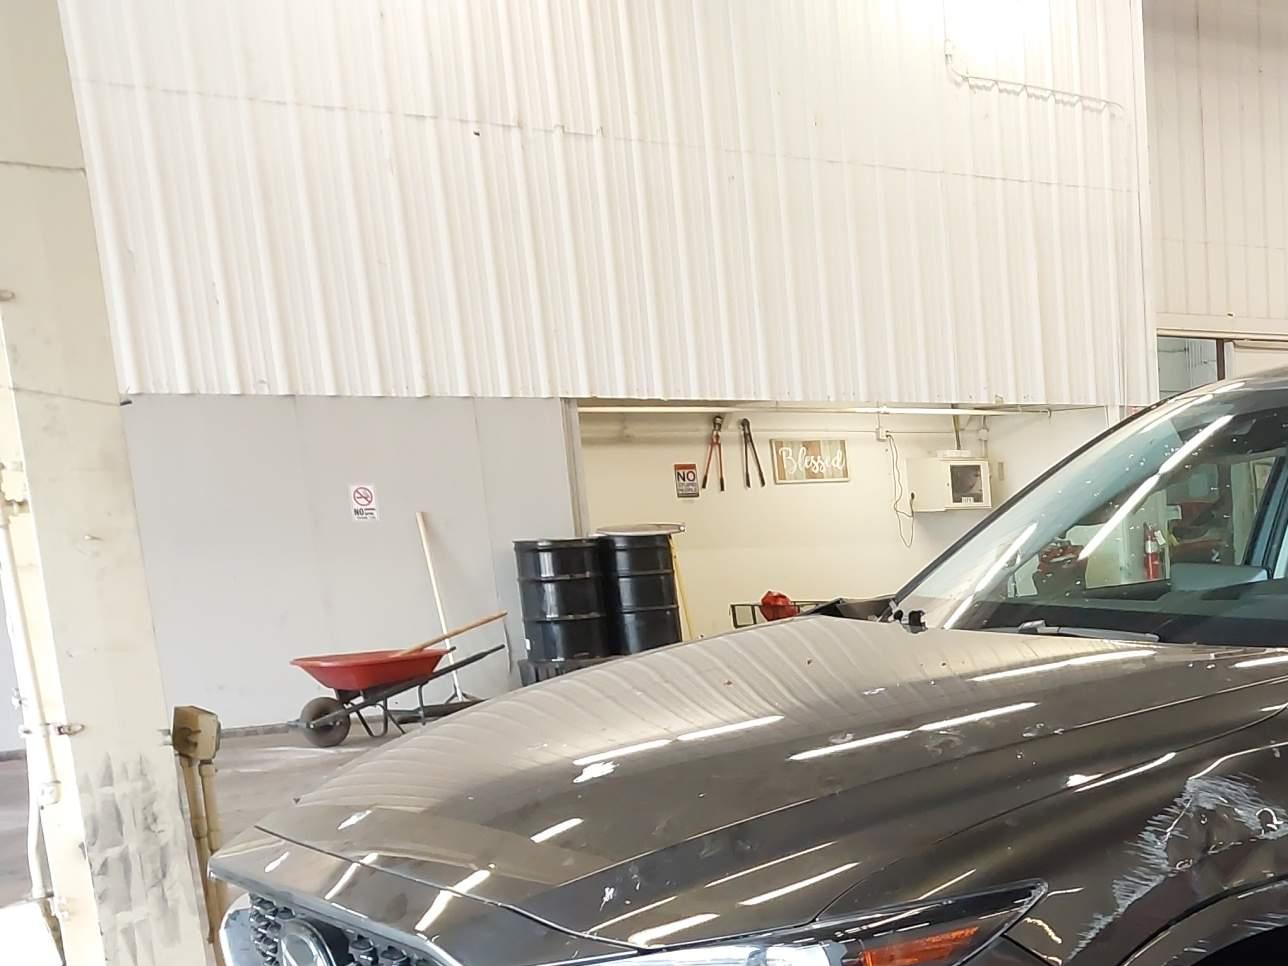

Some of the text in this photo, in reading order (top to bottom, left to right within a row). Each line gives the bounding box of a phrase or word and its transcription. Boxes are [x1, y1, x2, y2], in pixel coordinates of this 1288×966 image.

[779, 447, 845, 474] Blessed
[677, 470, 696, 482] NO
[354, 508, 365, 516] NO
